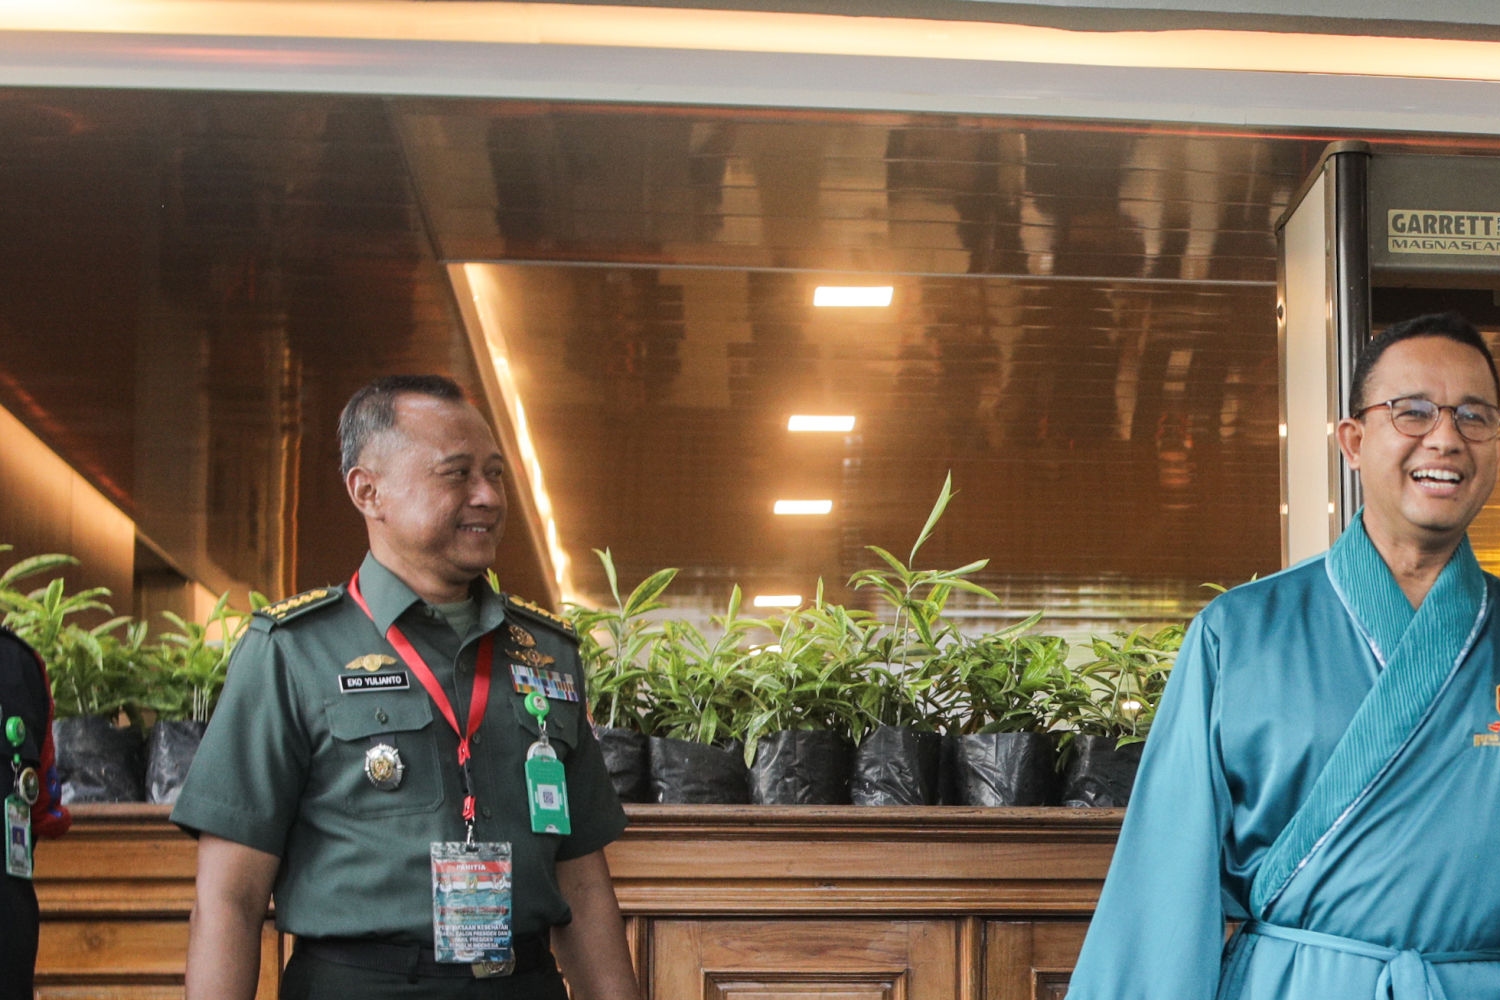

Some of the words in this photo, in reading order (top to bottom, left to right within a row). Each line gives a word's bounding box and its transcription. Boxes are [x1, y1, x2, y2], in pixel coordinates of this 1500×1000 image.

[1392, 214, 1494, 236] GARRETT
[347, 678, 363, 687] EKO
[365, 676, 402, 686] YULIANTO
